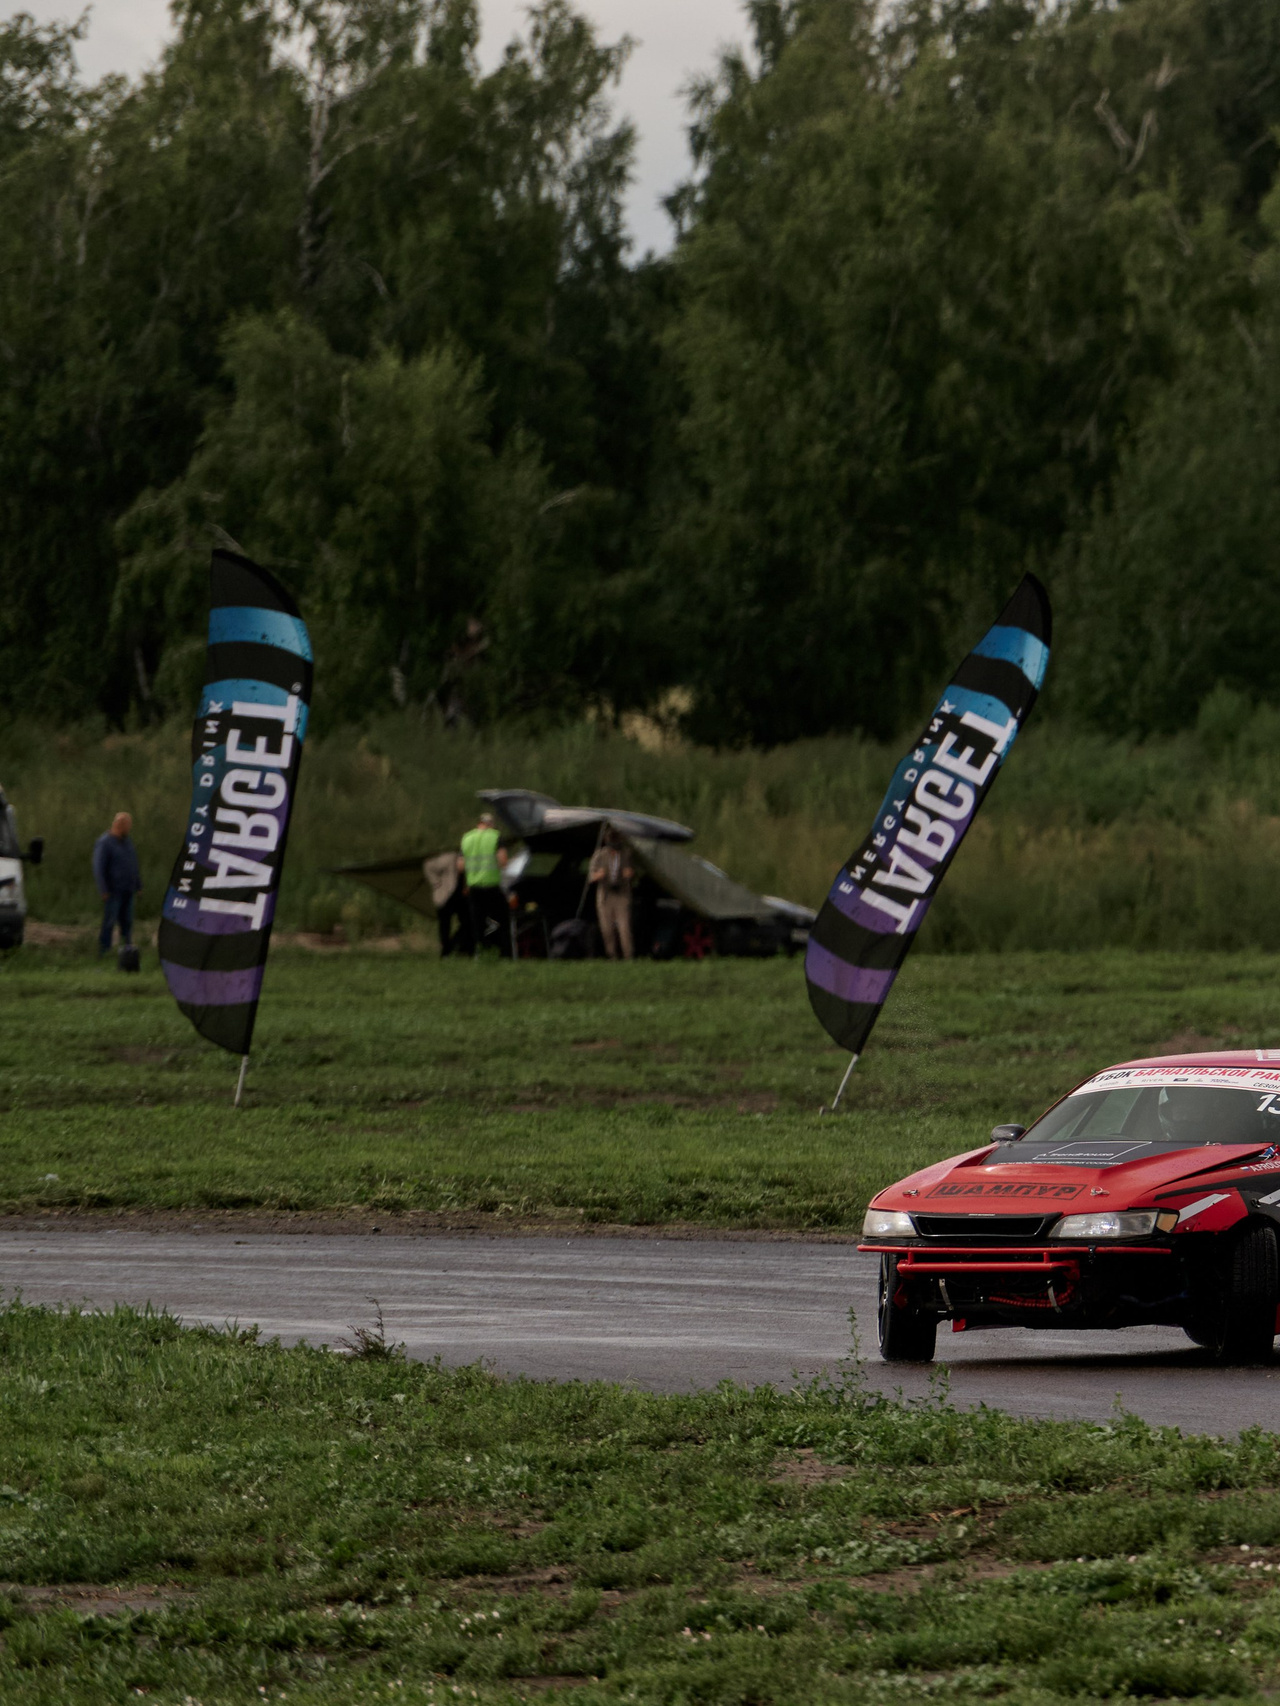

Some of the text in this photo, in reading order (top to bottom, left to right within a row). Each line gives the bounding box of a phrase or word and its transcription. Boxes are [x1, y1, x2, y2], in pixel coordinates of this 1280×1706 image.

[1089, 1070, 1135, 1084] КУБОК
[1134, 1068, 1251, 1078] БАРНАУЛЬСКОЙ
[1252, 1082, 1280, 1090] СЕЗОН
[937, 1184, 1077, 1198] ШАМПУР
